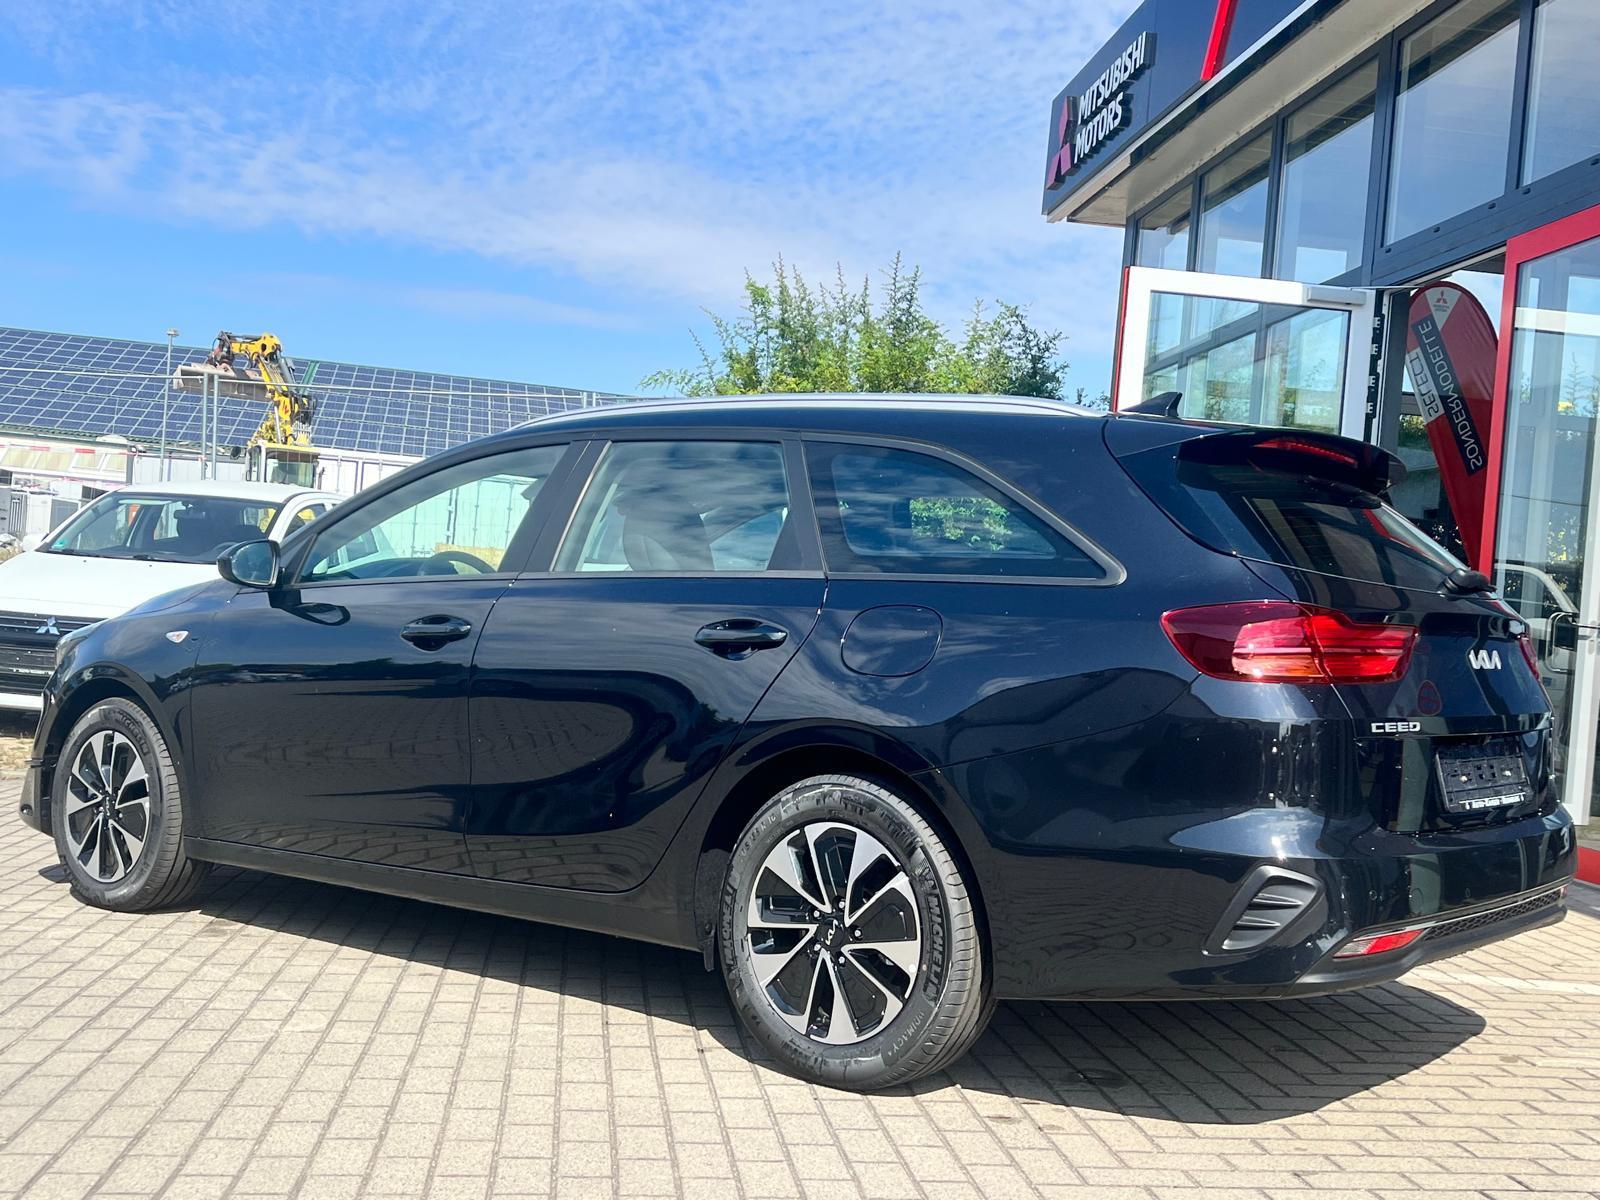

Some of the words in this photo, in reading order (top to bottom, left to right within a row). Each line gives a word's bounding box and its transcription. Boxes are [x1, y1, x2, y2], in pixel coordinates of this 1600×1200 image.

[1078, 31, 1148, 125] MITSUBISHI
[1074, 92, 1124, 164] MOTORS
[1469, 650, 1501, 670] KIA
[1371, 721, 1421, 733] CEED
